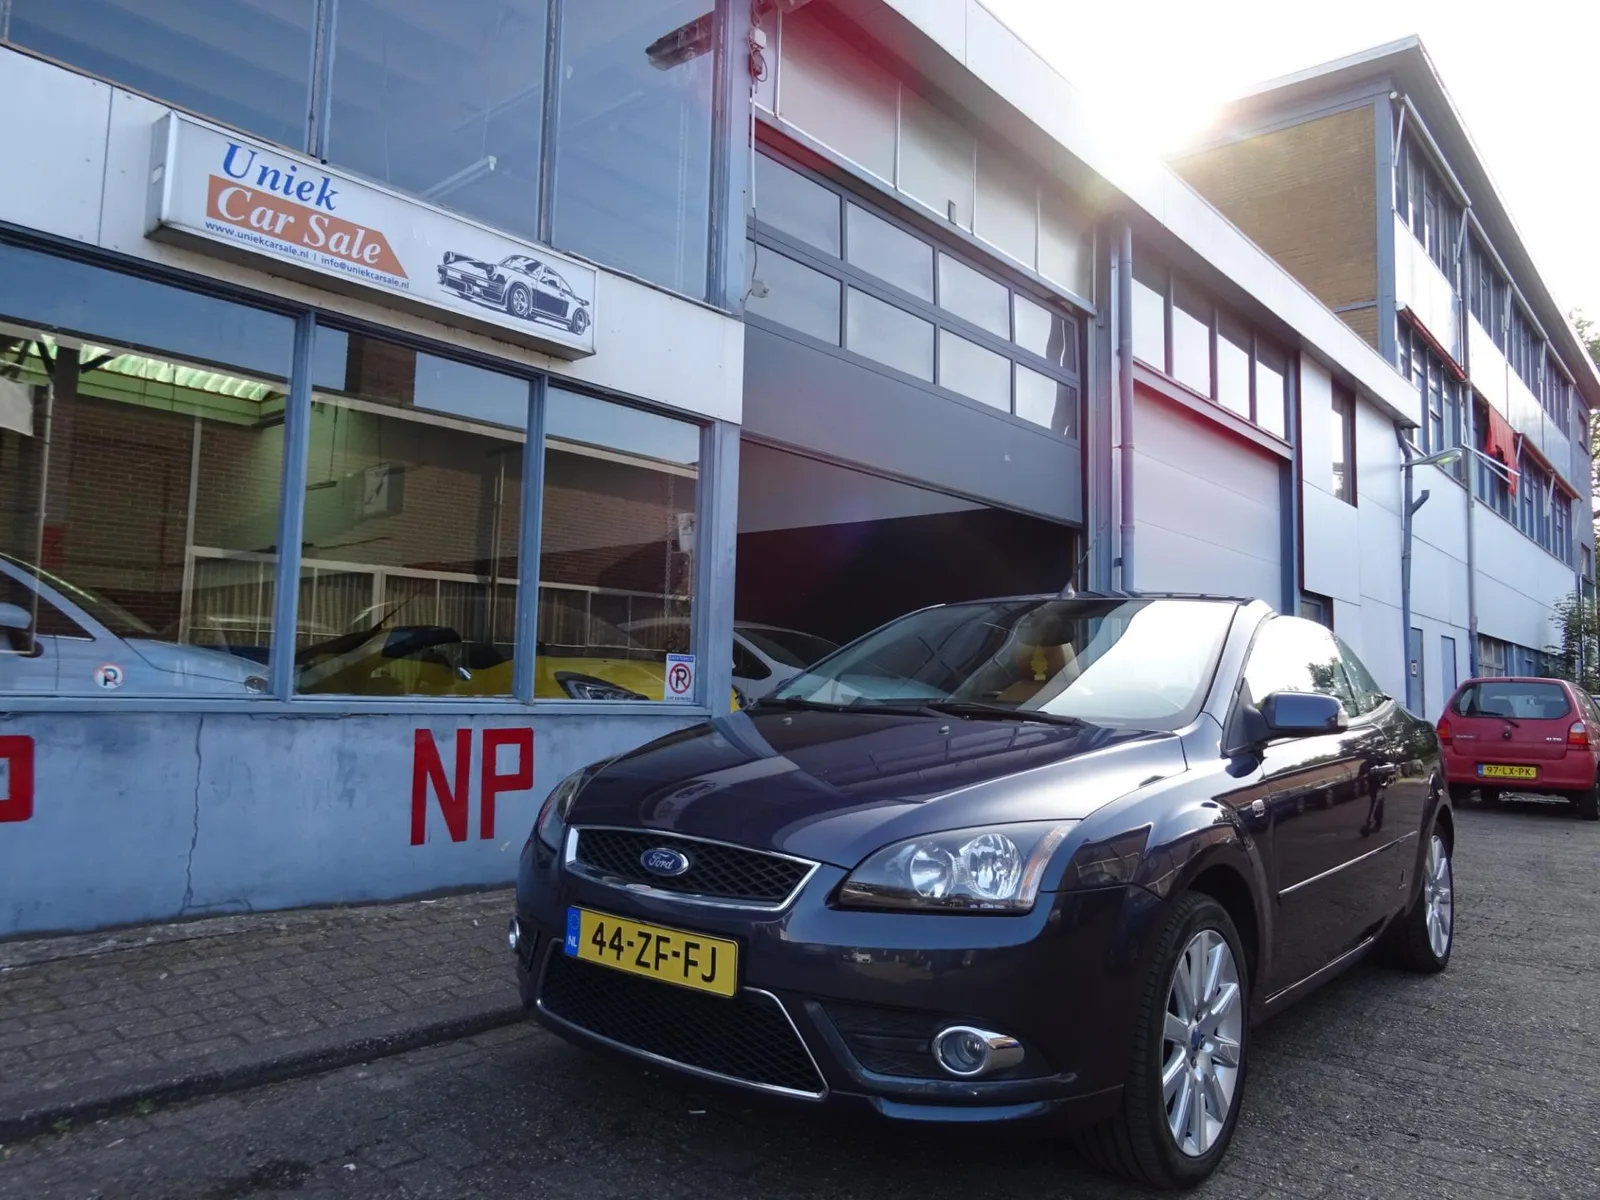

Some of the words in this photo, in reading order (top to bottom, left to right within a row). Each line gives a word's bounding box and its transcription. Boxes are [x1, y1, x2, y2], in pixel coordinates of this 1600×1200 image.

[222, 141, 340, 211] Uniek
[205, 220, 309, 259] www.uniekcarsale.nl
[321, 255, 410, 290] info@uniekcarsale.nl
[217, 186, 296, 235] Car
[303, 214, 382, 265] Sale
[410, 726, 534, 846] NP
[1486, 766, 1532, 776] 97-LX-PK
[648, 851, 676, 870] Ford
[567, 935, 579, 948] NL
[591, 921, 718, 983] 44-ZF-FJ
